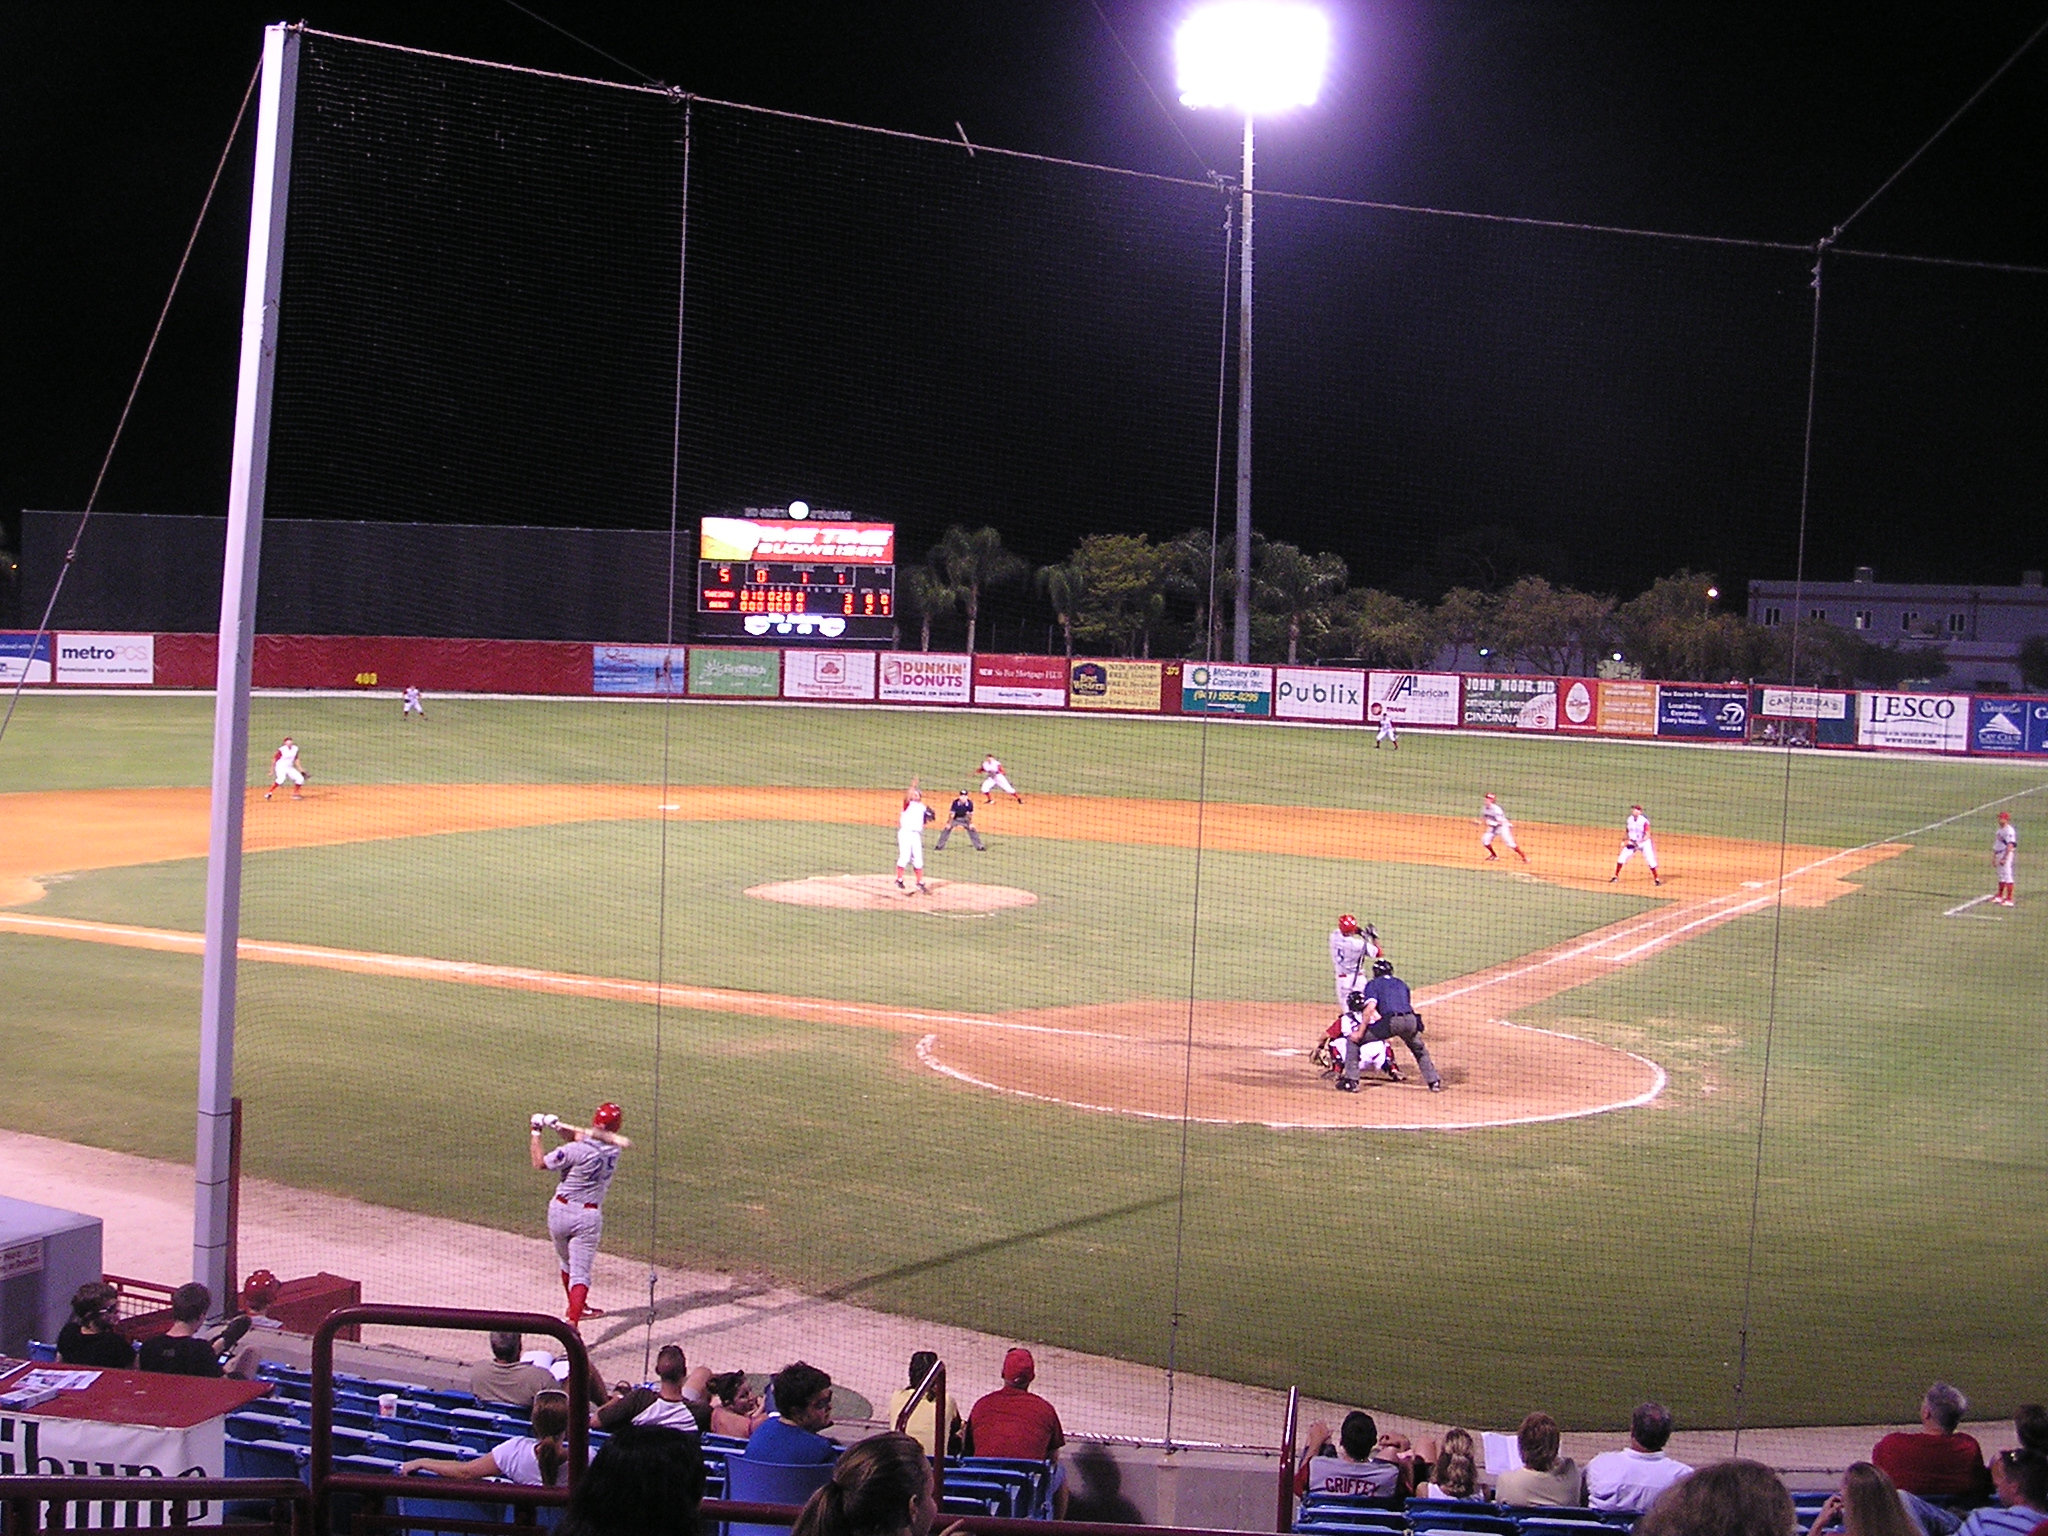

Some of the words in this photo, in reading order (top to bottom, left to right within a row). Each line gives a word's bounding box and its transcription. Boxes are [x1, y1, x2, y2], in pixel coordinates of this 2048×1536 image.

[757, 542, 884, 557] BUDWEISER
[719, 569, 730, 583] 5
[757, 570, 767, 583] 0
[62, 645, 147, 661] metroPCS
[903, 662, 967, 675] DUNKIN'
[903, 674, 963, 687] DONUTS
[1465, 678, 1495, 690] JOHN
[1279, 681, 1358, 705] Publix
[1870, 695, 1955, 723] LESCO
[1326, 1477, 1380, 1497] GRIFFEY
